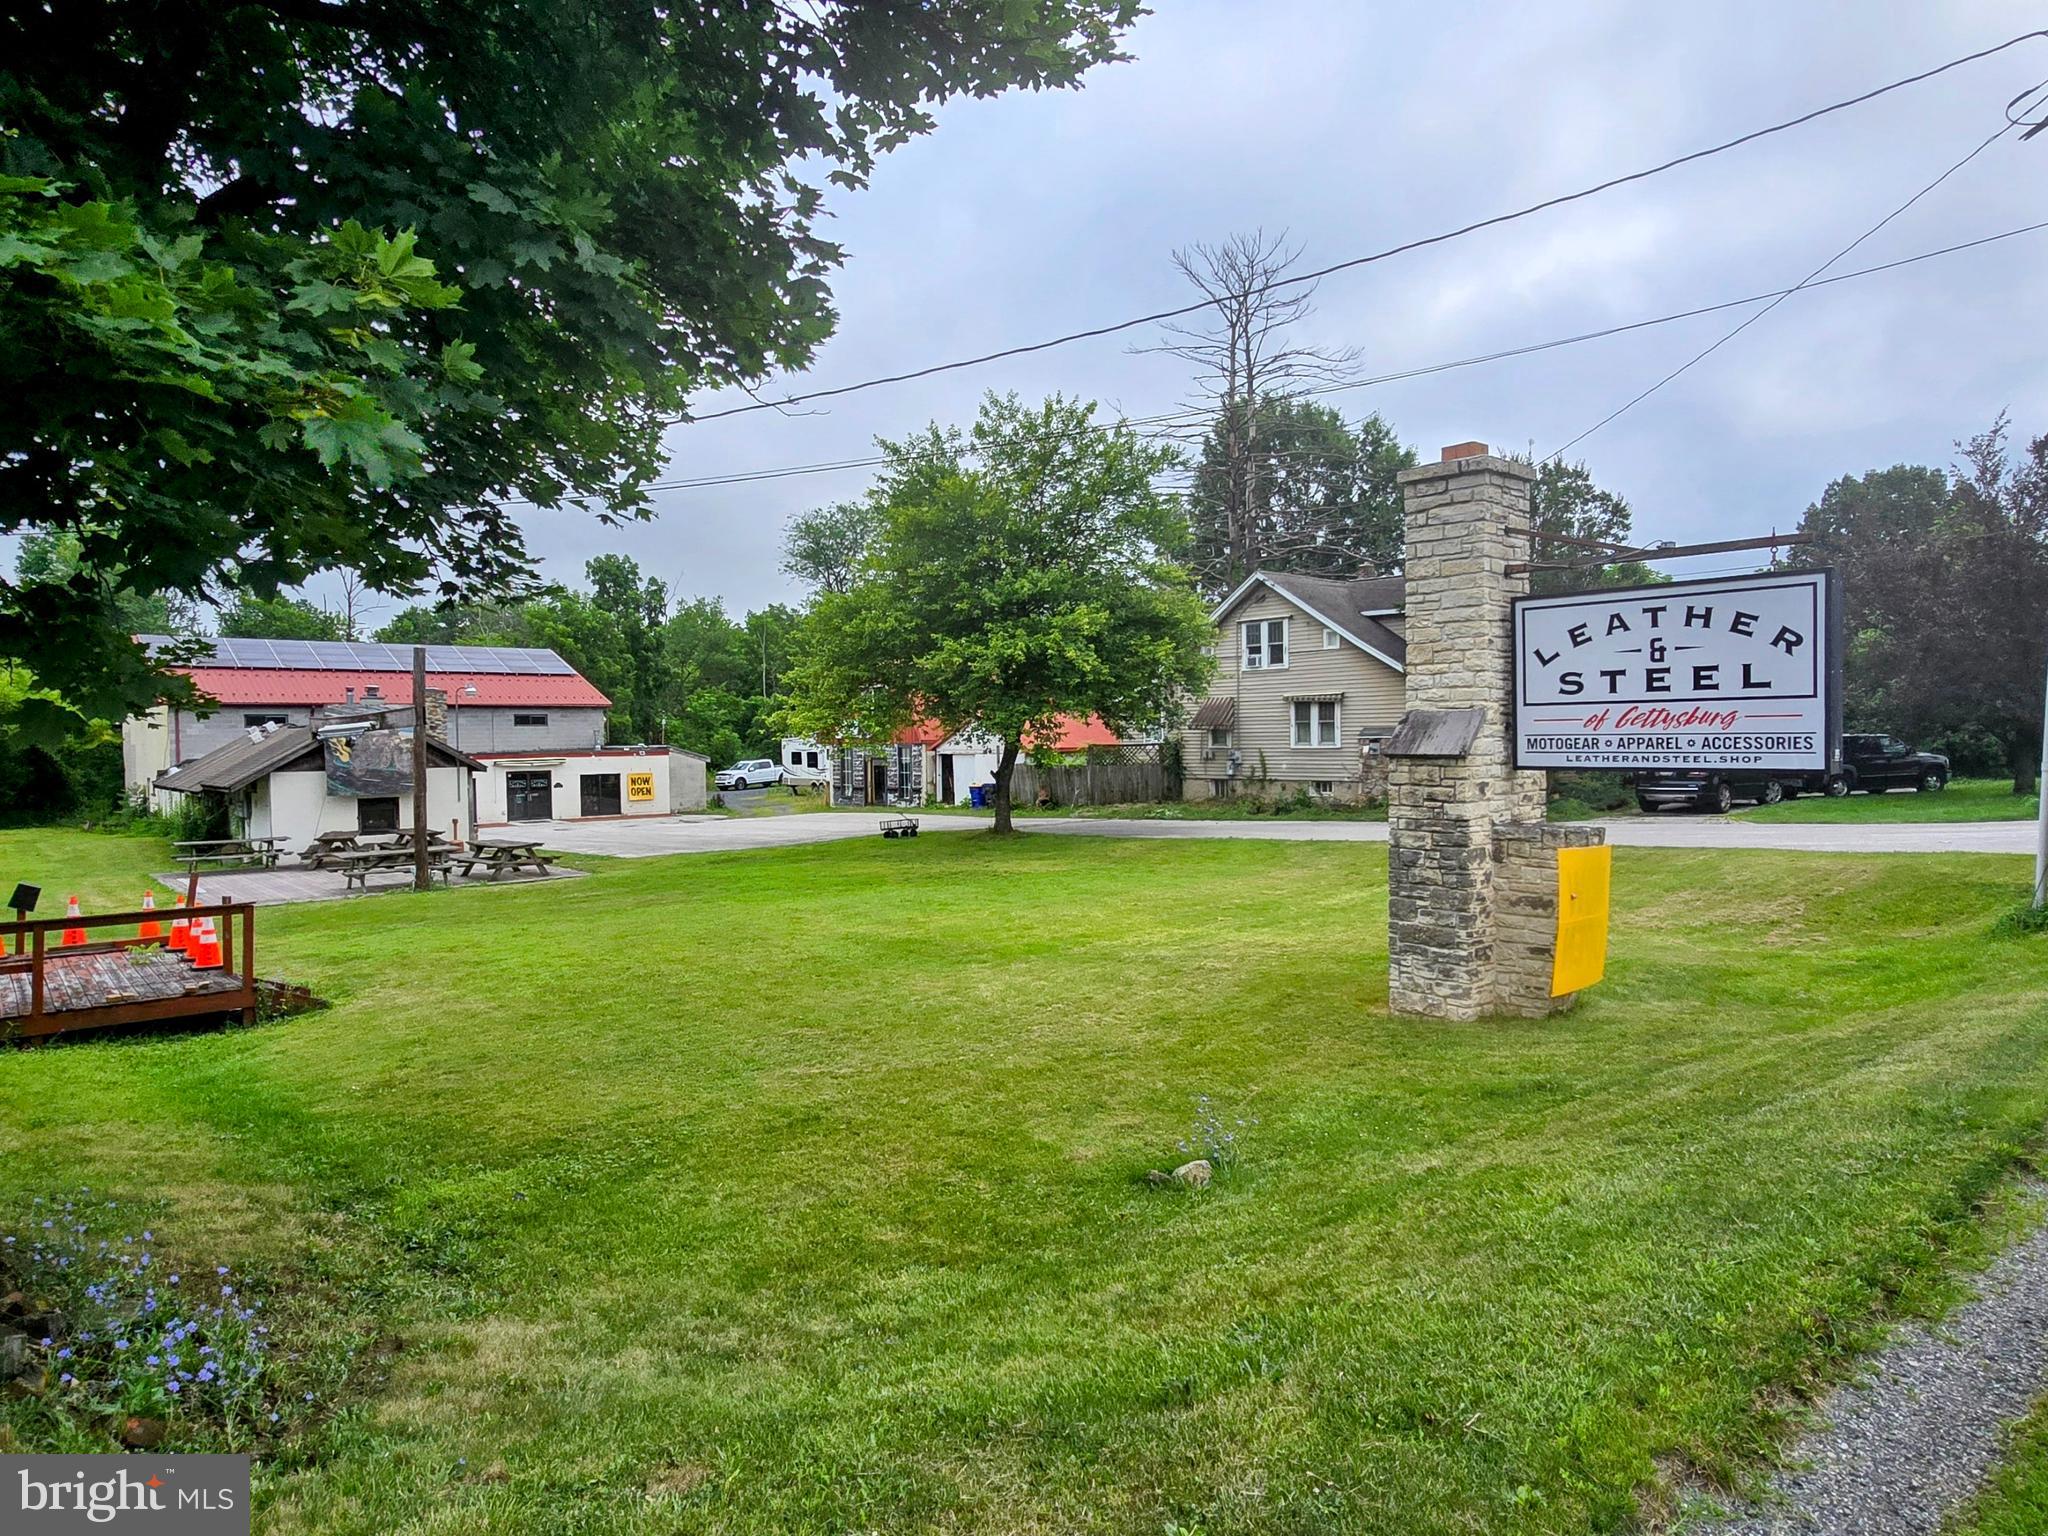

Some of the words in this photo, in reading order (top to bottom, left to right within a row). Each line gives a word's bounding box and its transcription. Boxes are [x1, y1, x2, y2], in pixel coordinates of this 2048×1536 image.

[1532, 605, 1804, 667] LEATHER
[1649, 637, 1667, 663] &
[1558, 663, 1772, 696] STEEL
[1583, 708, 1610, 731] of
[1615, 705, 1742, 731] Gettysburg
[1526, 737, 1600, 750] MOTOGEAR
[1616, 736, 1683, 750] APPAREL
[1701, 735, 1814, 750] ACCESSORIES
[1566, 754, 1763, 764] LEATHERANDSTEEL.SHOP
[630, 777, 651, 786] NOW
[631, 787, 652, 796] OPEN
